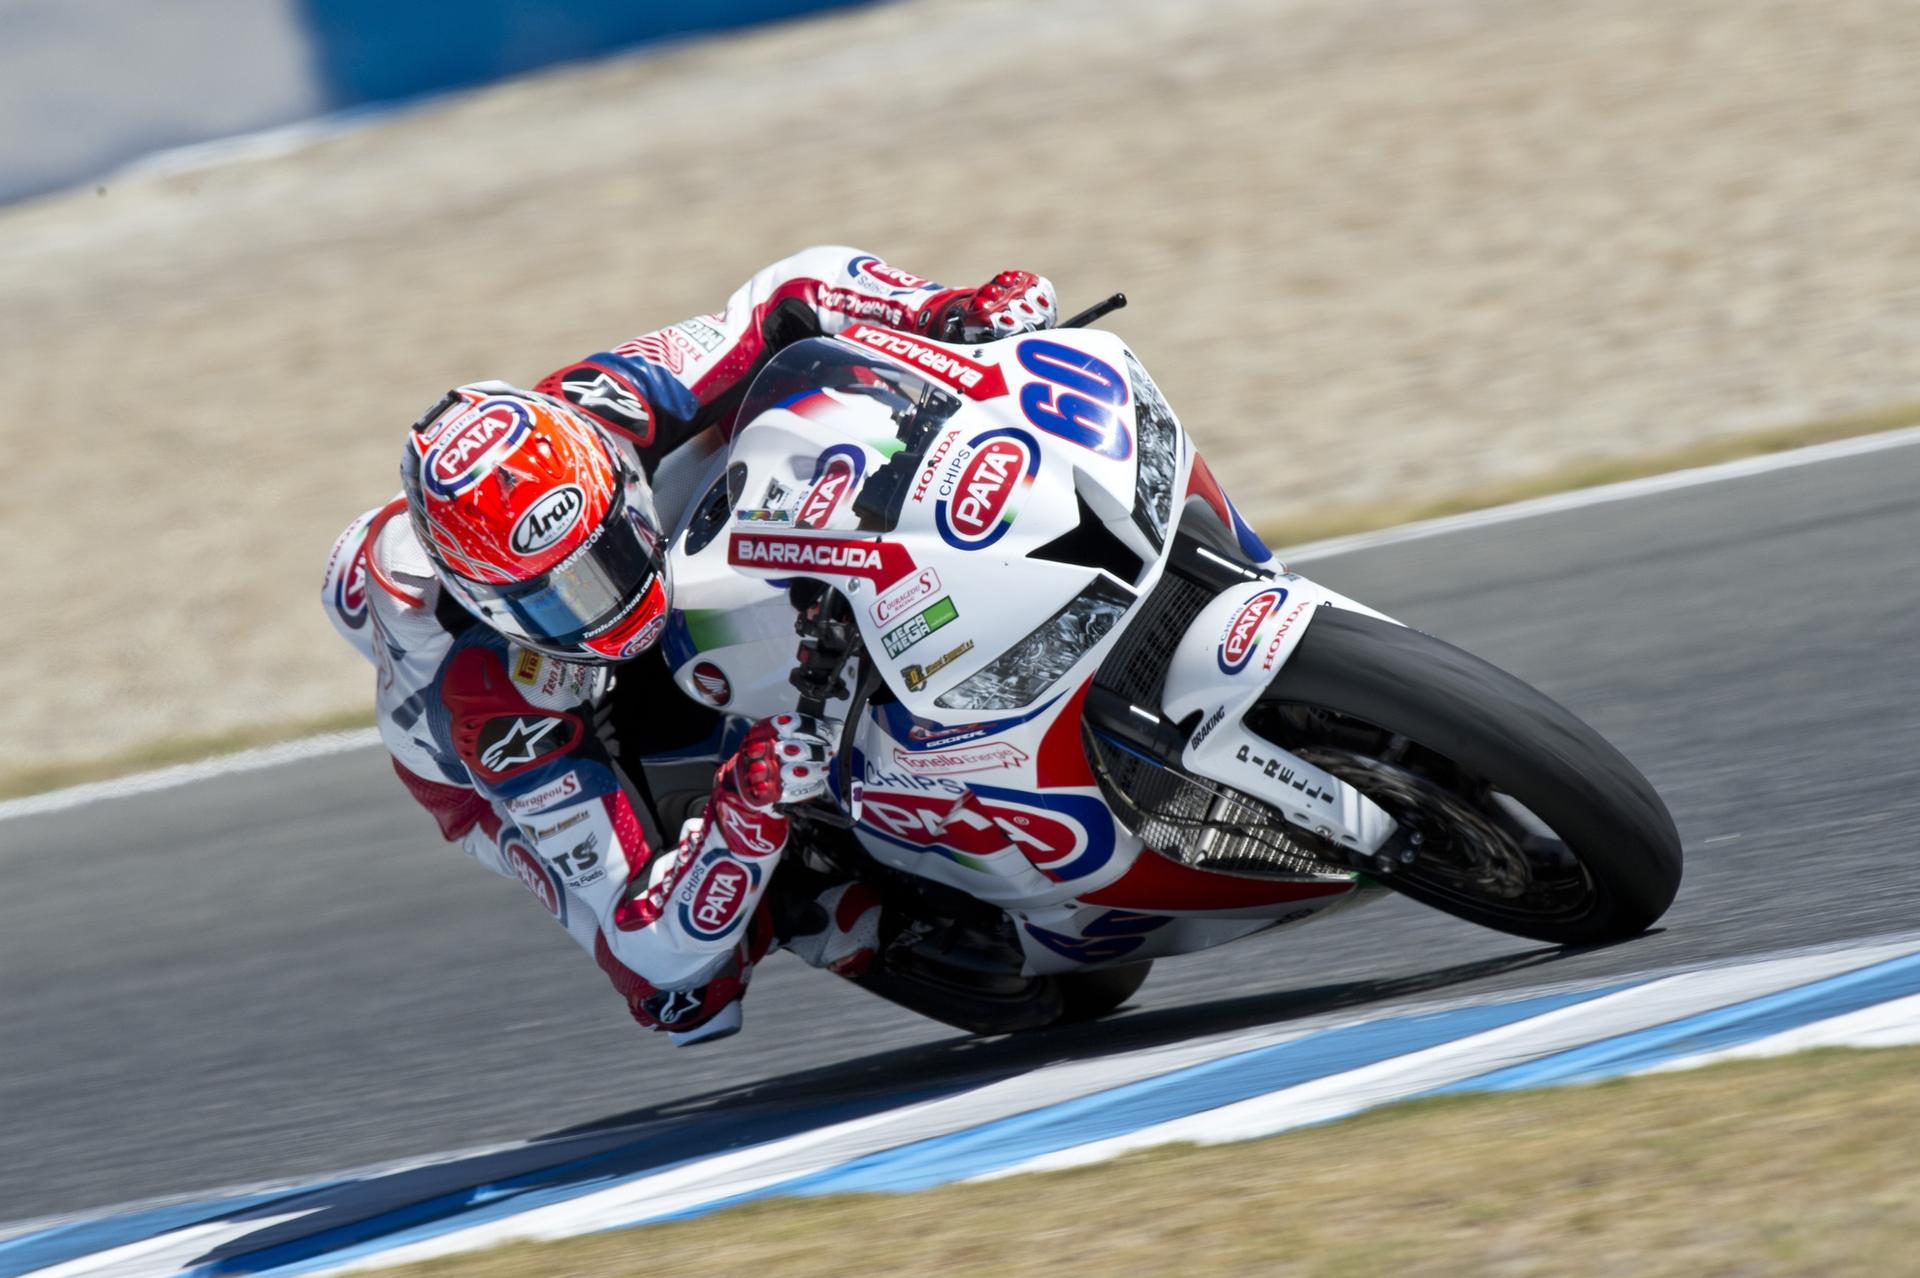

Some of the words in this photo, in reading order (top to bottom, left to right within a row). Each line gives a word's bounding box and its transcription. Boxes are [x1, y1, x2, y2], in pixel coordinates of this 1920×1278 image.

[854, 328, 983, 388] BARRACUDA
[1015, 339, 1133, 461] 60
[439, 416, 508, 475] PATA
[912, 429, 962, 504] HONDA
[939, 448, 971, 496] CHIPS
[803, 474, 848, 526] ATA
[956, 452, 1018, 528] PATA
[523, 488, 576, 552] Arai
[552, 523, 606, 575] HAVECON
[737, 540, 883, 571] BARRACUDA
[1220, 605, 1246, 643] CHIPS
[1229, 597, 1272, 655] PATA
[1262, 600, 1311, 672] HONDA
[1191, 704, 1226, 751] BRAKING
[865, 761, 964, 795] CHIPS
[897, 754, 964, 769] Tonello
[1236, 744, 1335, 804] PIRELLI
[681, 863, 705, 902] CHIPS
[697, 873, 743, 926] PATA
